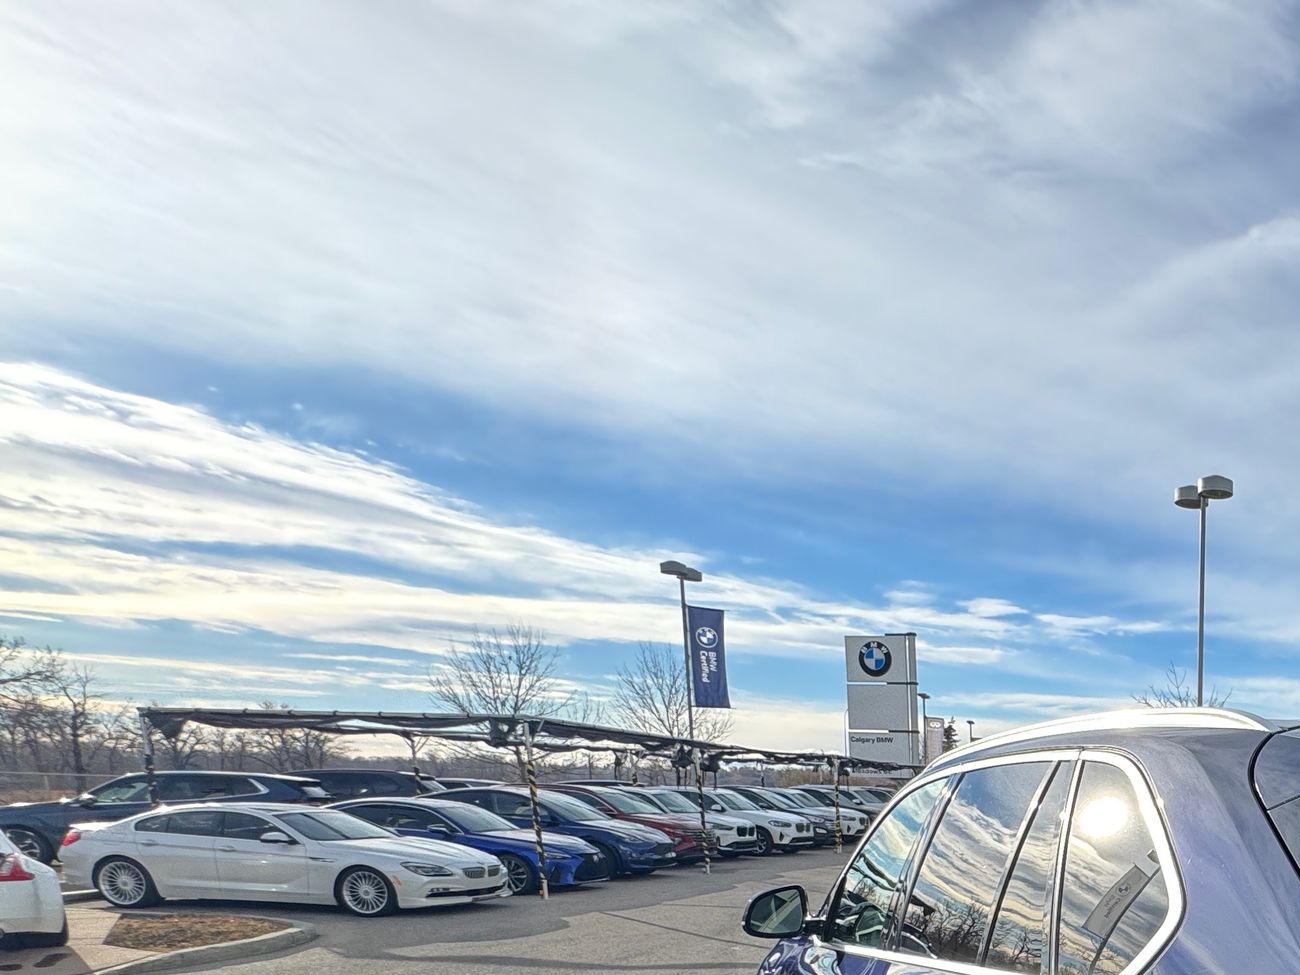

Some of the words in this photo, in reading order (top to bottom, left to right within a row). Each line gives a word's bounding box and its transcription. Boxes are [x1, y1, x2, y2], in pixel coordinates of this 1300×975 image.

[861, 641, 888, 654] BMW
[699, 650, 711, 683] Certified
[708, 651, 718, 672] BMW
[850, 736, 876, 744] Calgary
